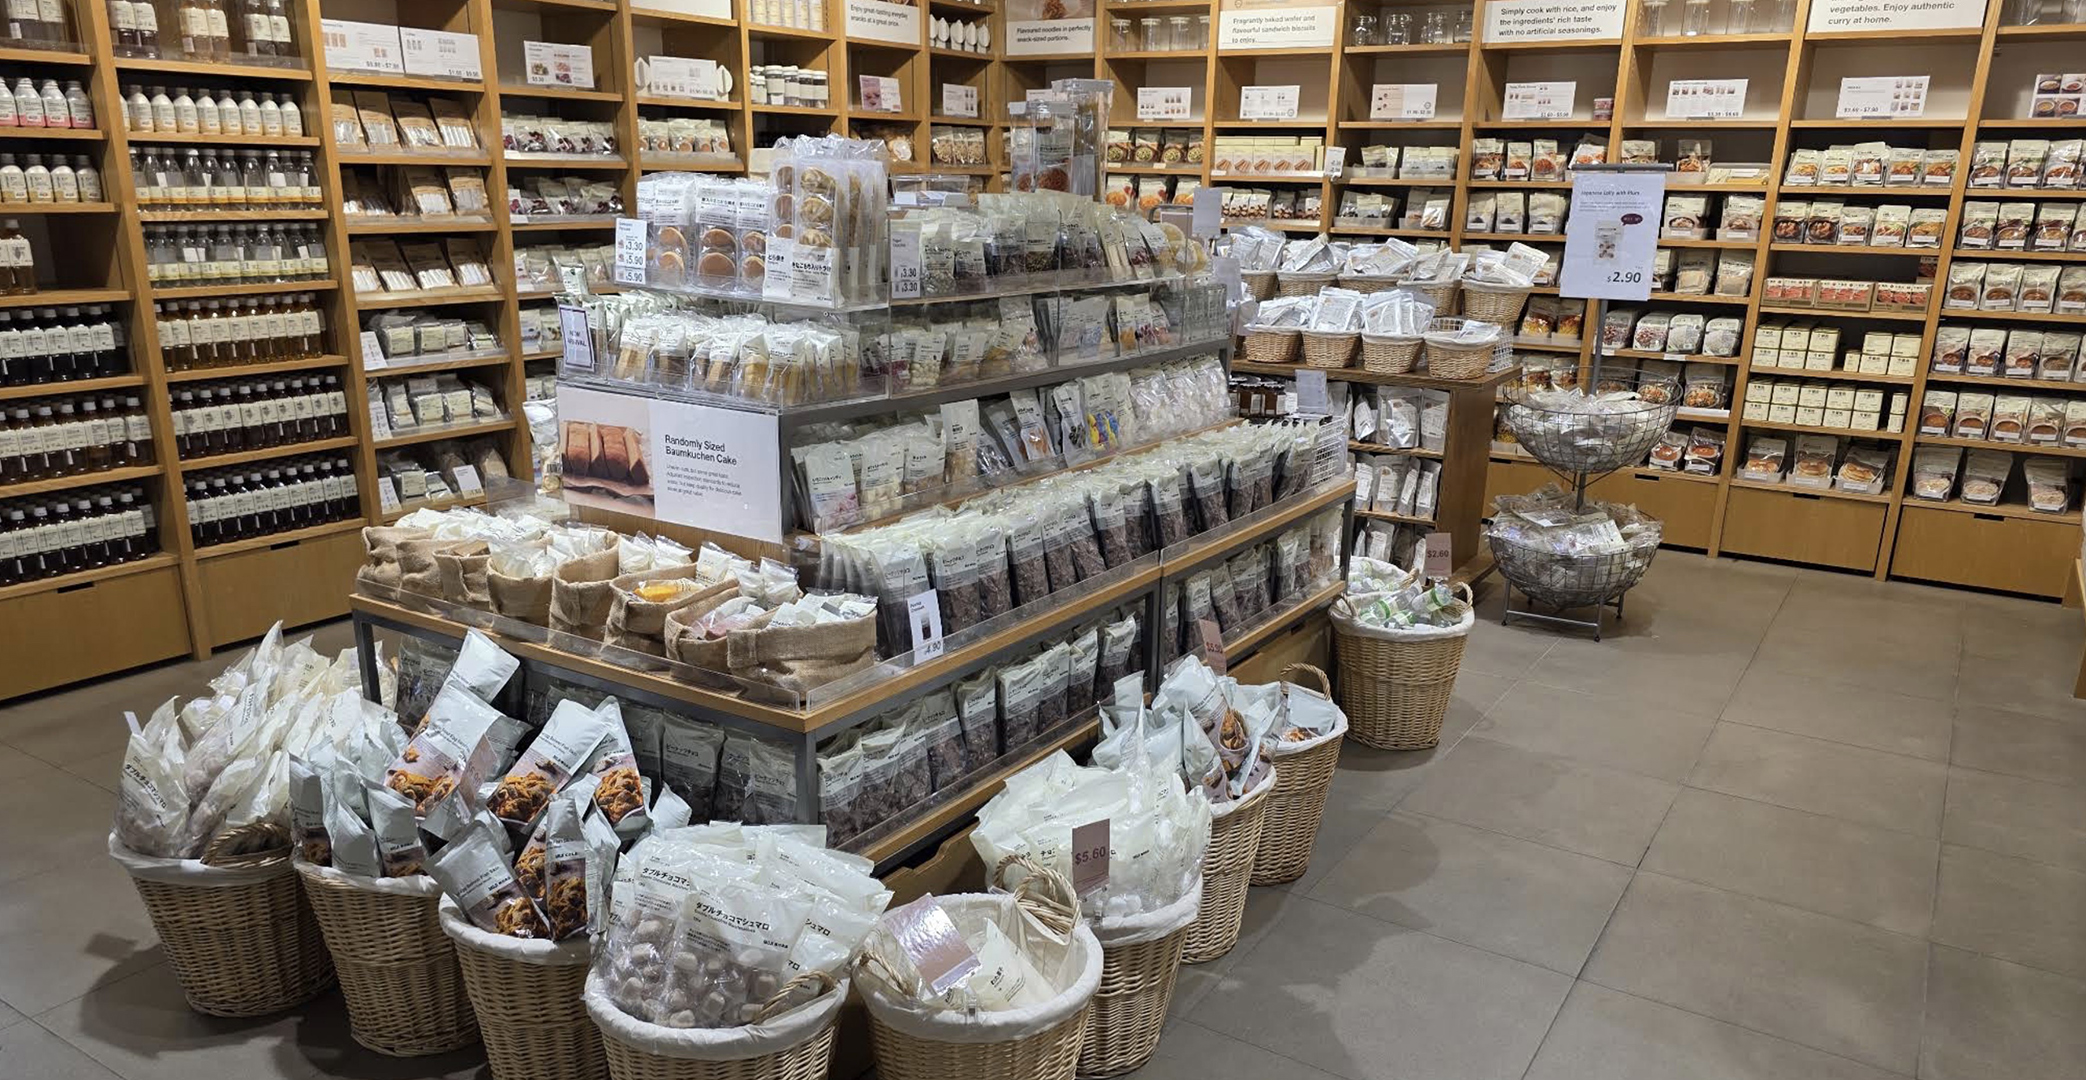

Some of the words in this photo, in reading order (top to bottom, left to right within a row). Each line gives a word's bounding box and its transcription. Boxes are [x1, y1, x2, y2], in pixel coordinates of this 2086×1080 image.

[1501, 8, 1525, 16] Simply
[1563, 5, 1578, 13] rice,
[1581, 4, 1594, 12] and
[1596, 4, 1617, 12] enjoy
[1830, 4, 1880, 14] vegetables.
[1883, 4, 1908, 12] Enjoy
[1911, 2, 1955, 10] authentic
[1233, 17, 1263, 25] Fragrantly
[1828, 17, 1851, 25] curry
[1853, 16, 1862, 24] at
[665, 434, 702, 449] Randomly
[704, 441, 725, 452] Sized
[666, 446, 715, 462] Baumkuchen
[716, 454, 737, 465] Cake
[1427, 550, 1449, 558] $2.60
[1075, 846, 1106, 865] $5.60
[696, 902, 770, 931] ダブルチョコマシュマロ
